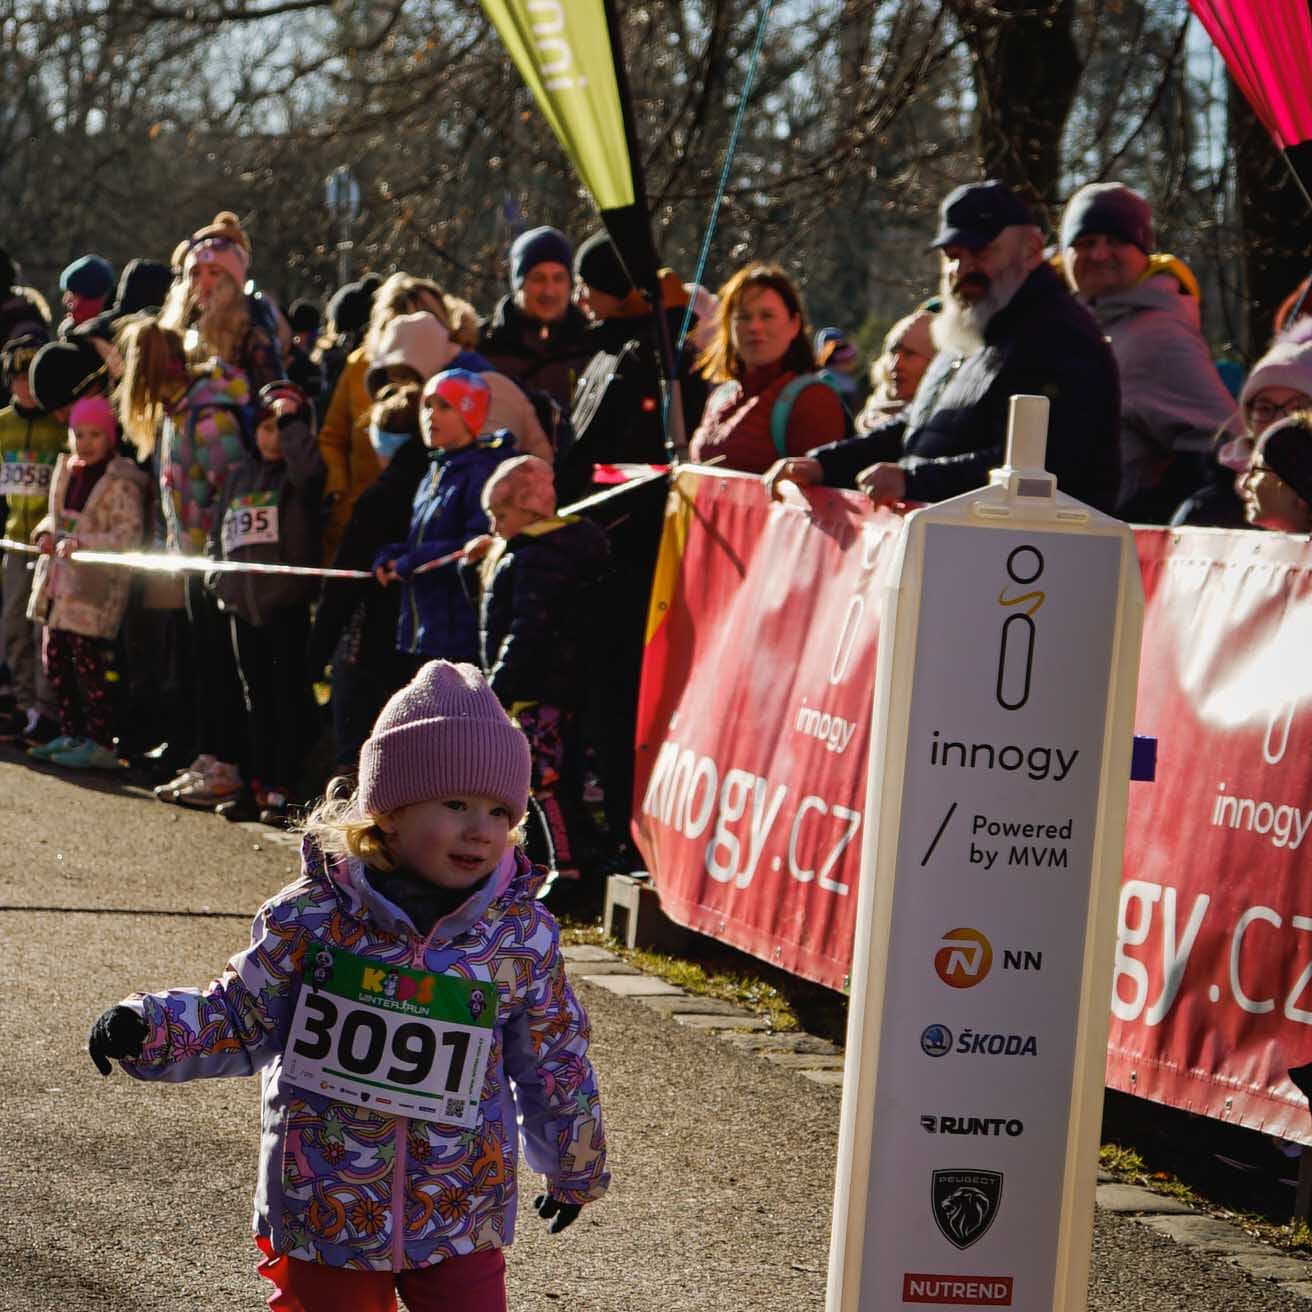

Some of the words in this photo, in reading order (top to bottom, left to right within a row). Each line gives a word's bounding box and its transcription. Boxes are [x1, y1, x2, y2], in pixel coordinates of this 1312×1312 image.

[795, 696, 857, 754] innogy
[930, 730, 1080, 783] innogy
[971, 814, 1074, 841] Powered
[1212, 781, 1312, 850] innogy
[968, 842, 999, 870] by
[1007, 845, 1069, 869] MVM
[1002, 949, 1043, 972] NN
[292, 992, 471, 1093] 3091
[956, 1027, 1039, 1057] ŠKODA
[939, 1115, 1025, 1137] RUNTO
[938, 1175, 997, 1186] PEUGEOT
[909, 1279, 1008, 1301] NUTREND
